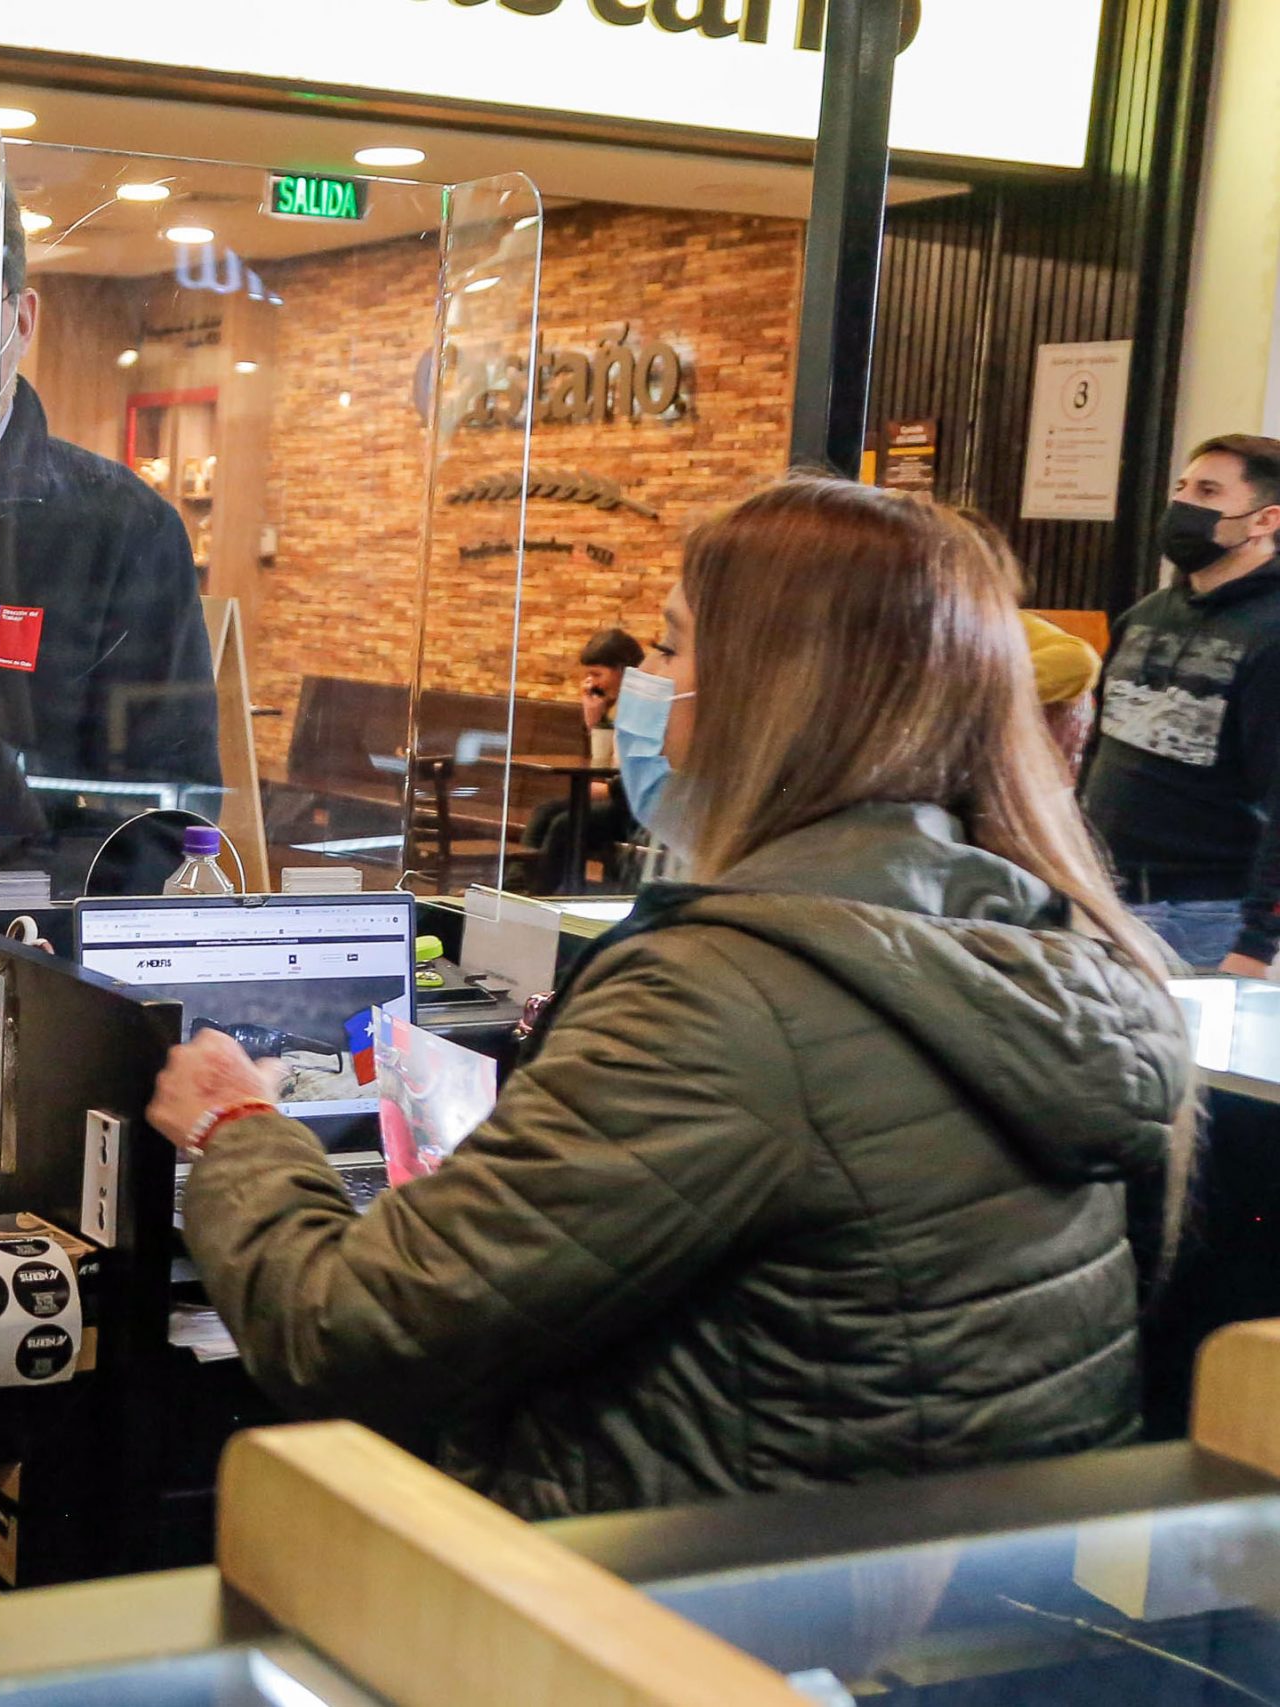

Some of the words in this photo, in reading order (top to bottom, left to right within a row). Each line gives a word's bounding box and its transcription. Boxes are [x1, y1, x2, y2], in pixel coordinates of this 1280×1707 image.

[278, 176, 357, 217] SALIDA
[413, 323, 680, 424] Cstaño
[1074, 381, 1088, 408] 3
